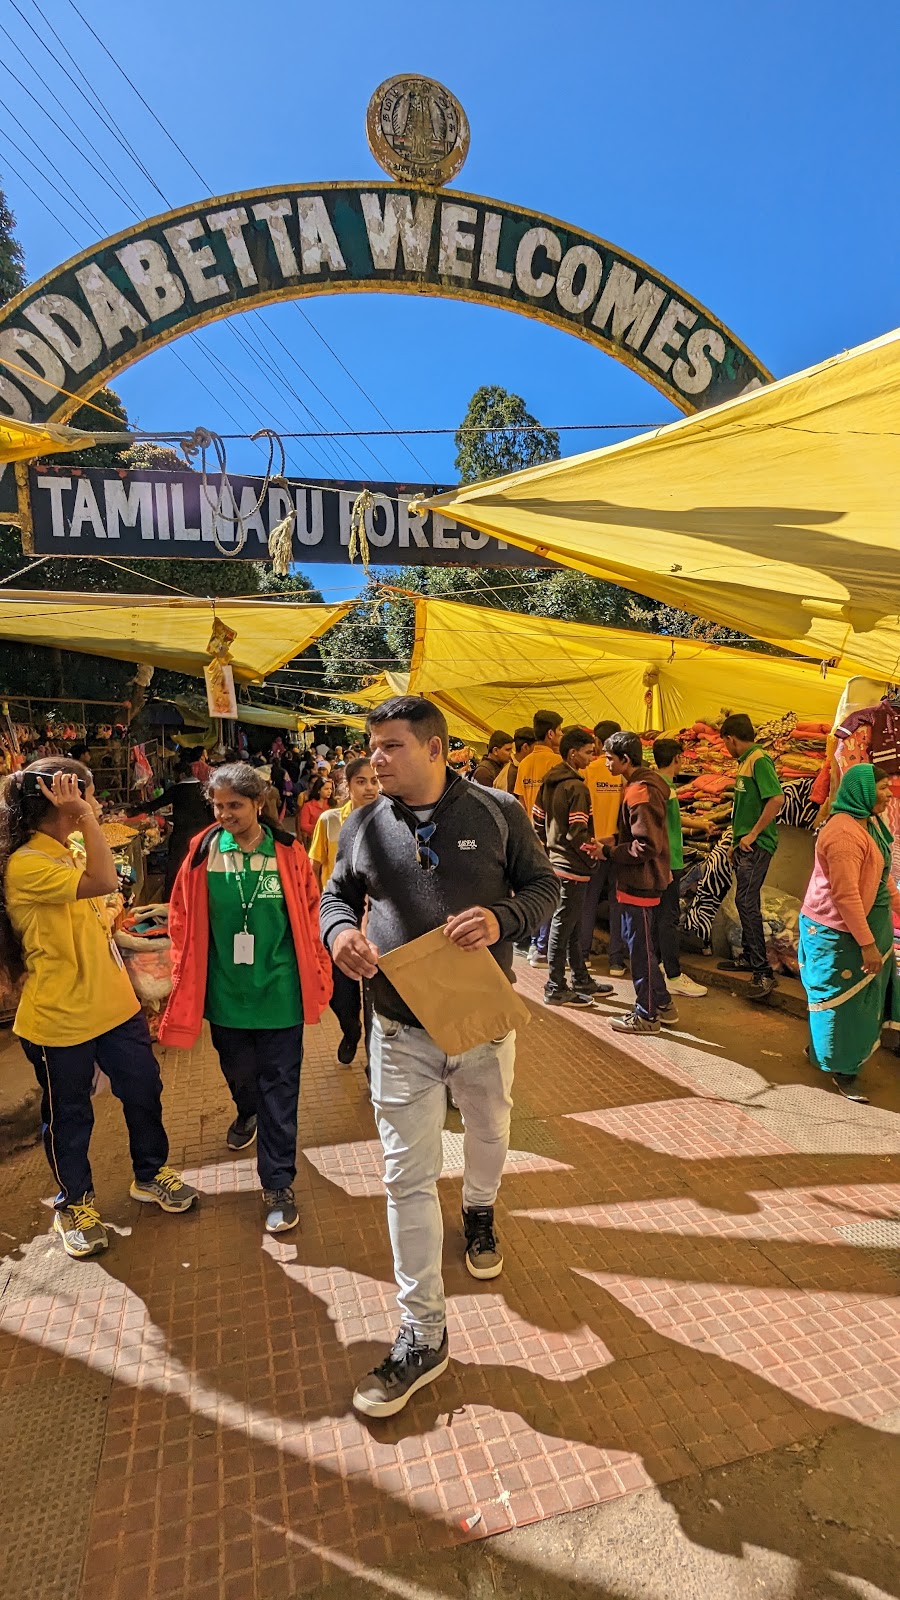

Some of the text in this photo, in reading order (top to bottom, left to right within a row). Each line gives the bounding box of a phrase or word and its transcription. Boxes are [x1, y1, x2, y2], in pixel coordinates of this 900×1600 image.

[0, 193, 726, 424] DDABETTA WELCOMES
[37, 476, 508, 550] TAMILNADU FORE
